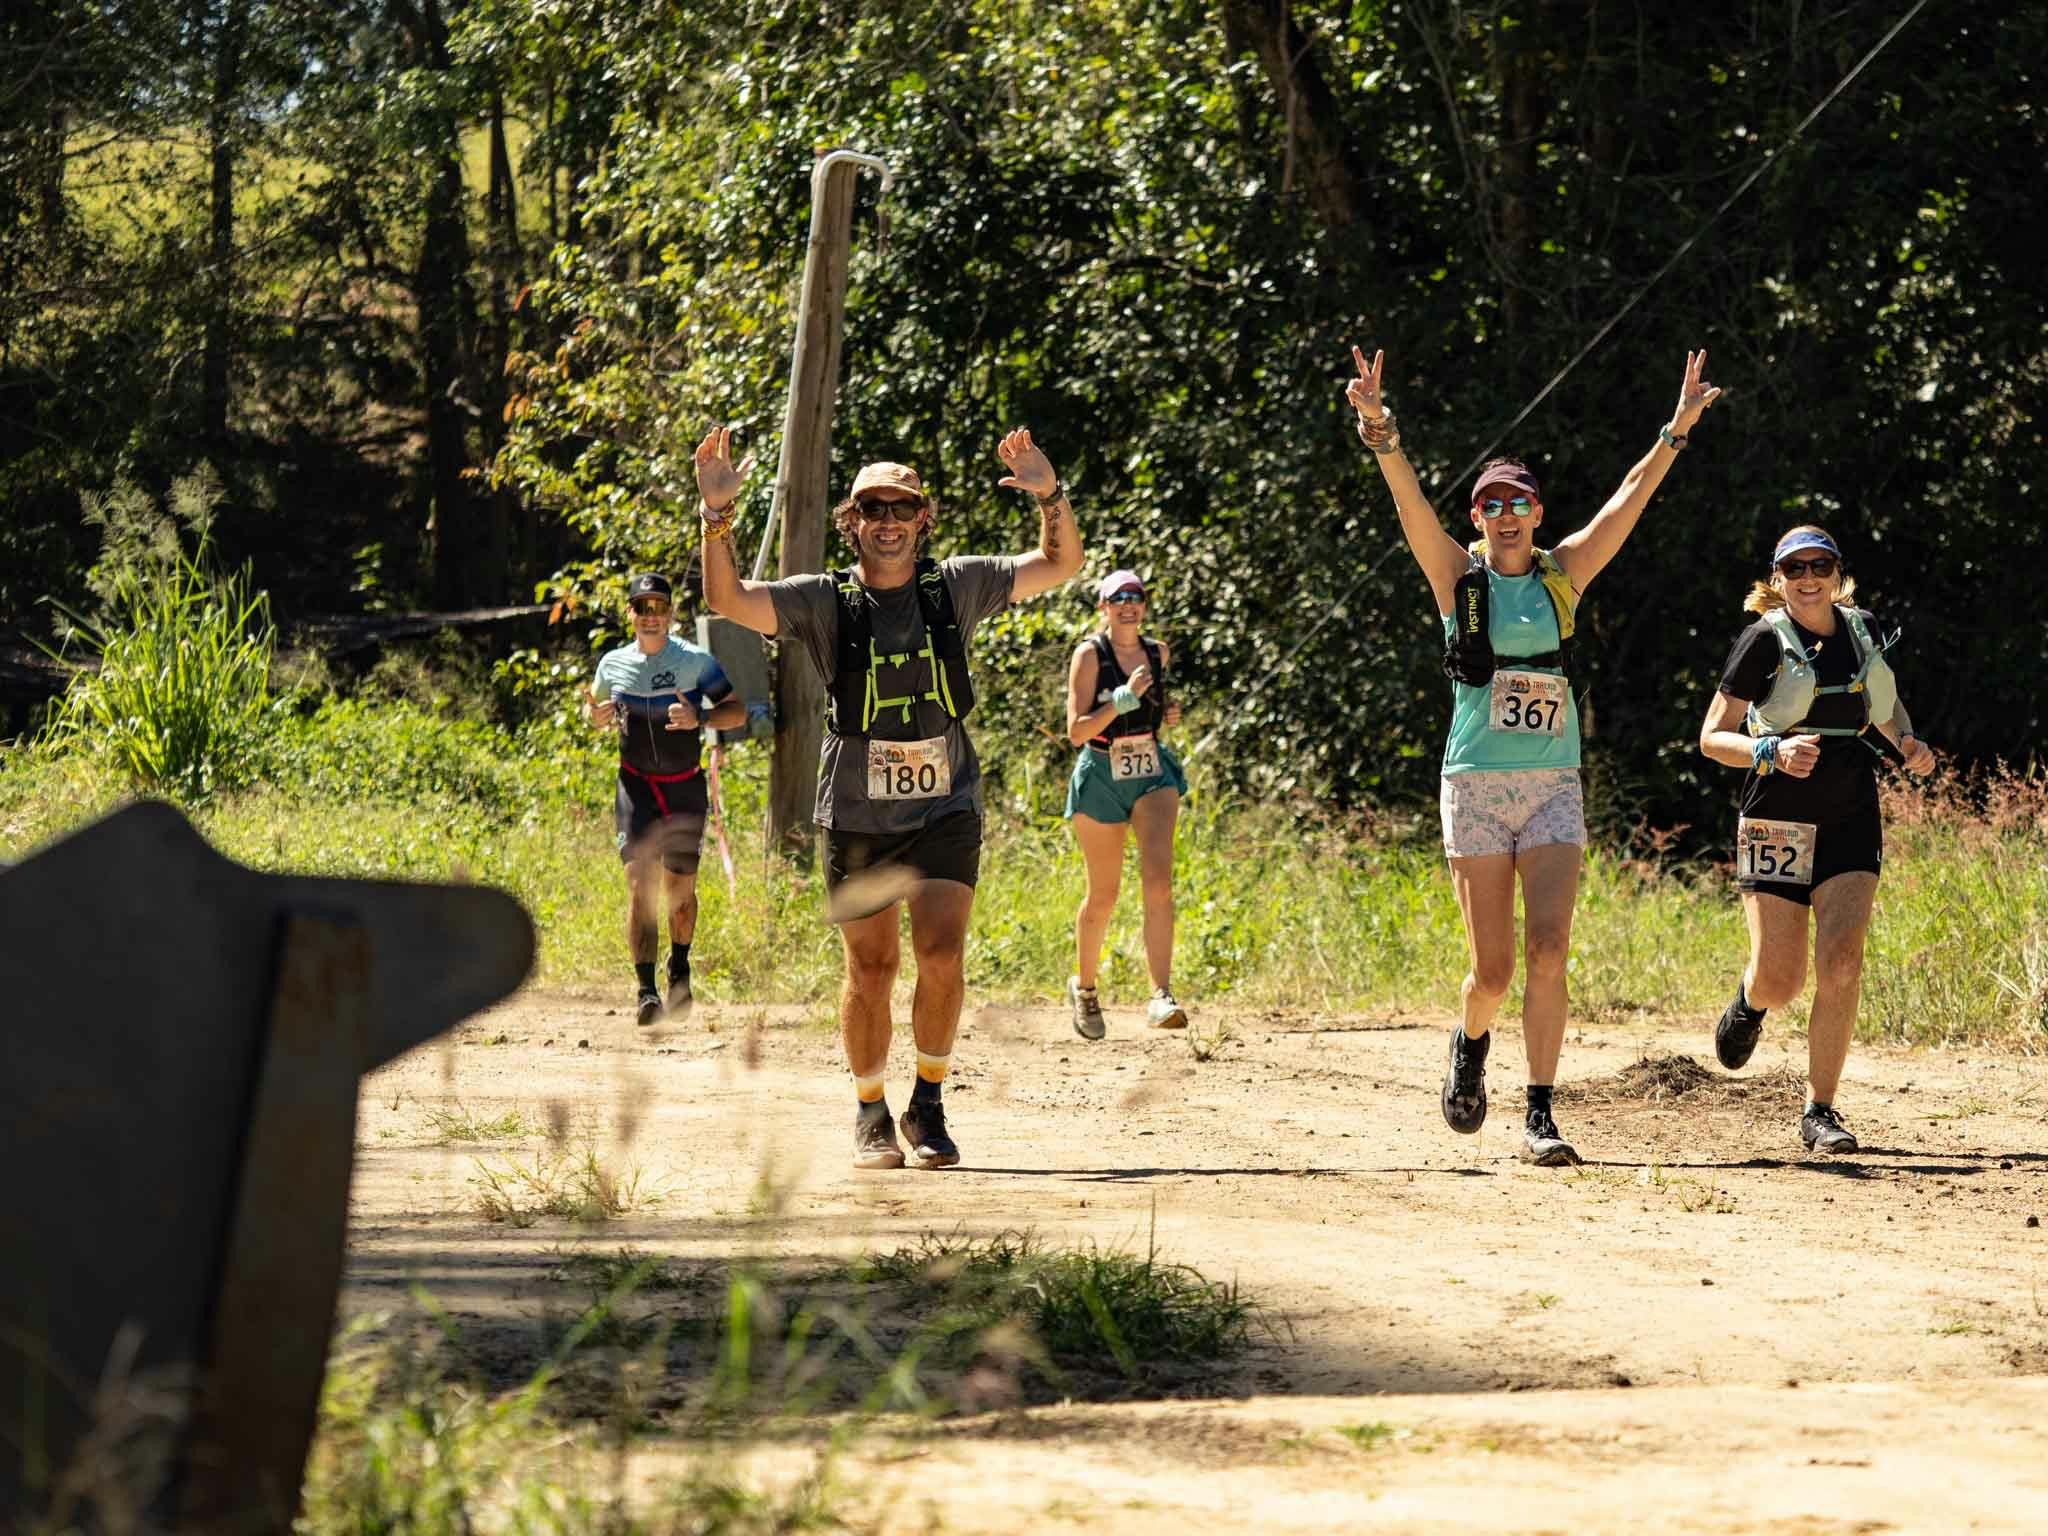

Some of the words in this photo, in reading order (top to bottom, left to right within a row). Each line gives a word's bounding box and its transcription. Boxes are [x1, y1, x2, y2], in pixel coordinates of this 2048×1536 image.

[1502, 695, 1559, 731] 367
[882, 763, 936, 795] 180
[1120, 753, 1153, 776] 373
[1748, 843, 1797, 876] 152
